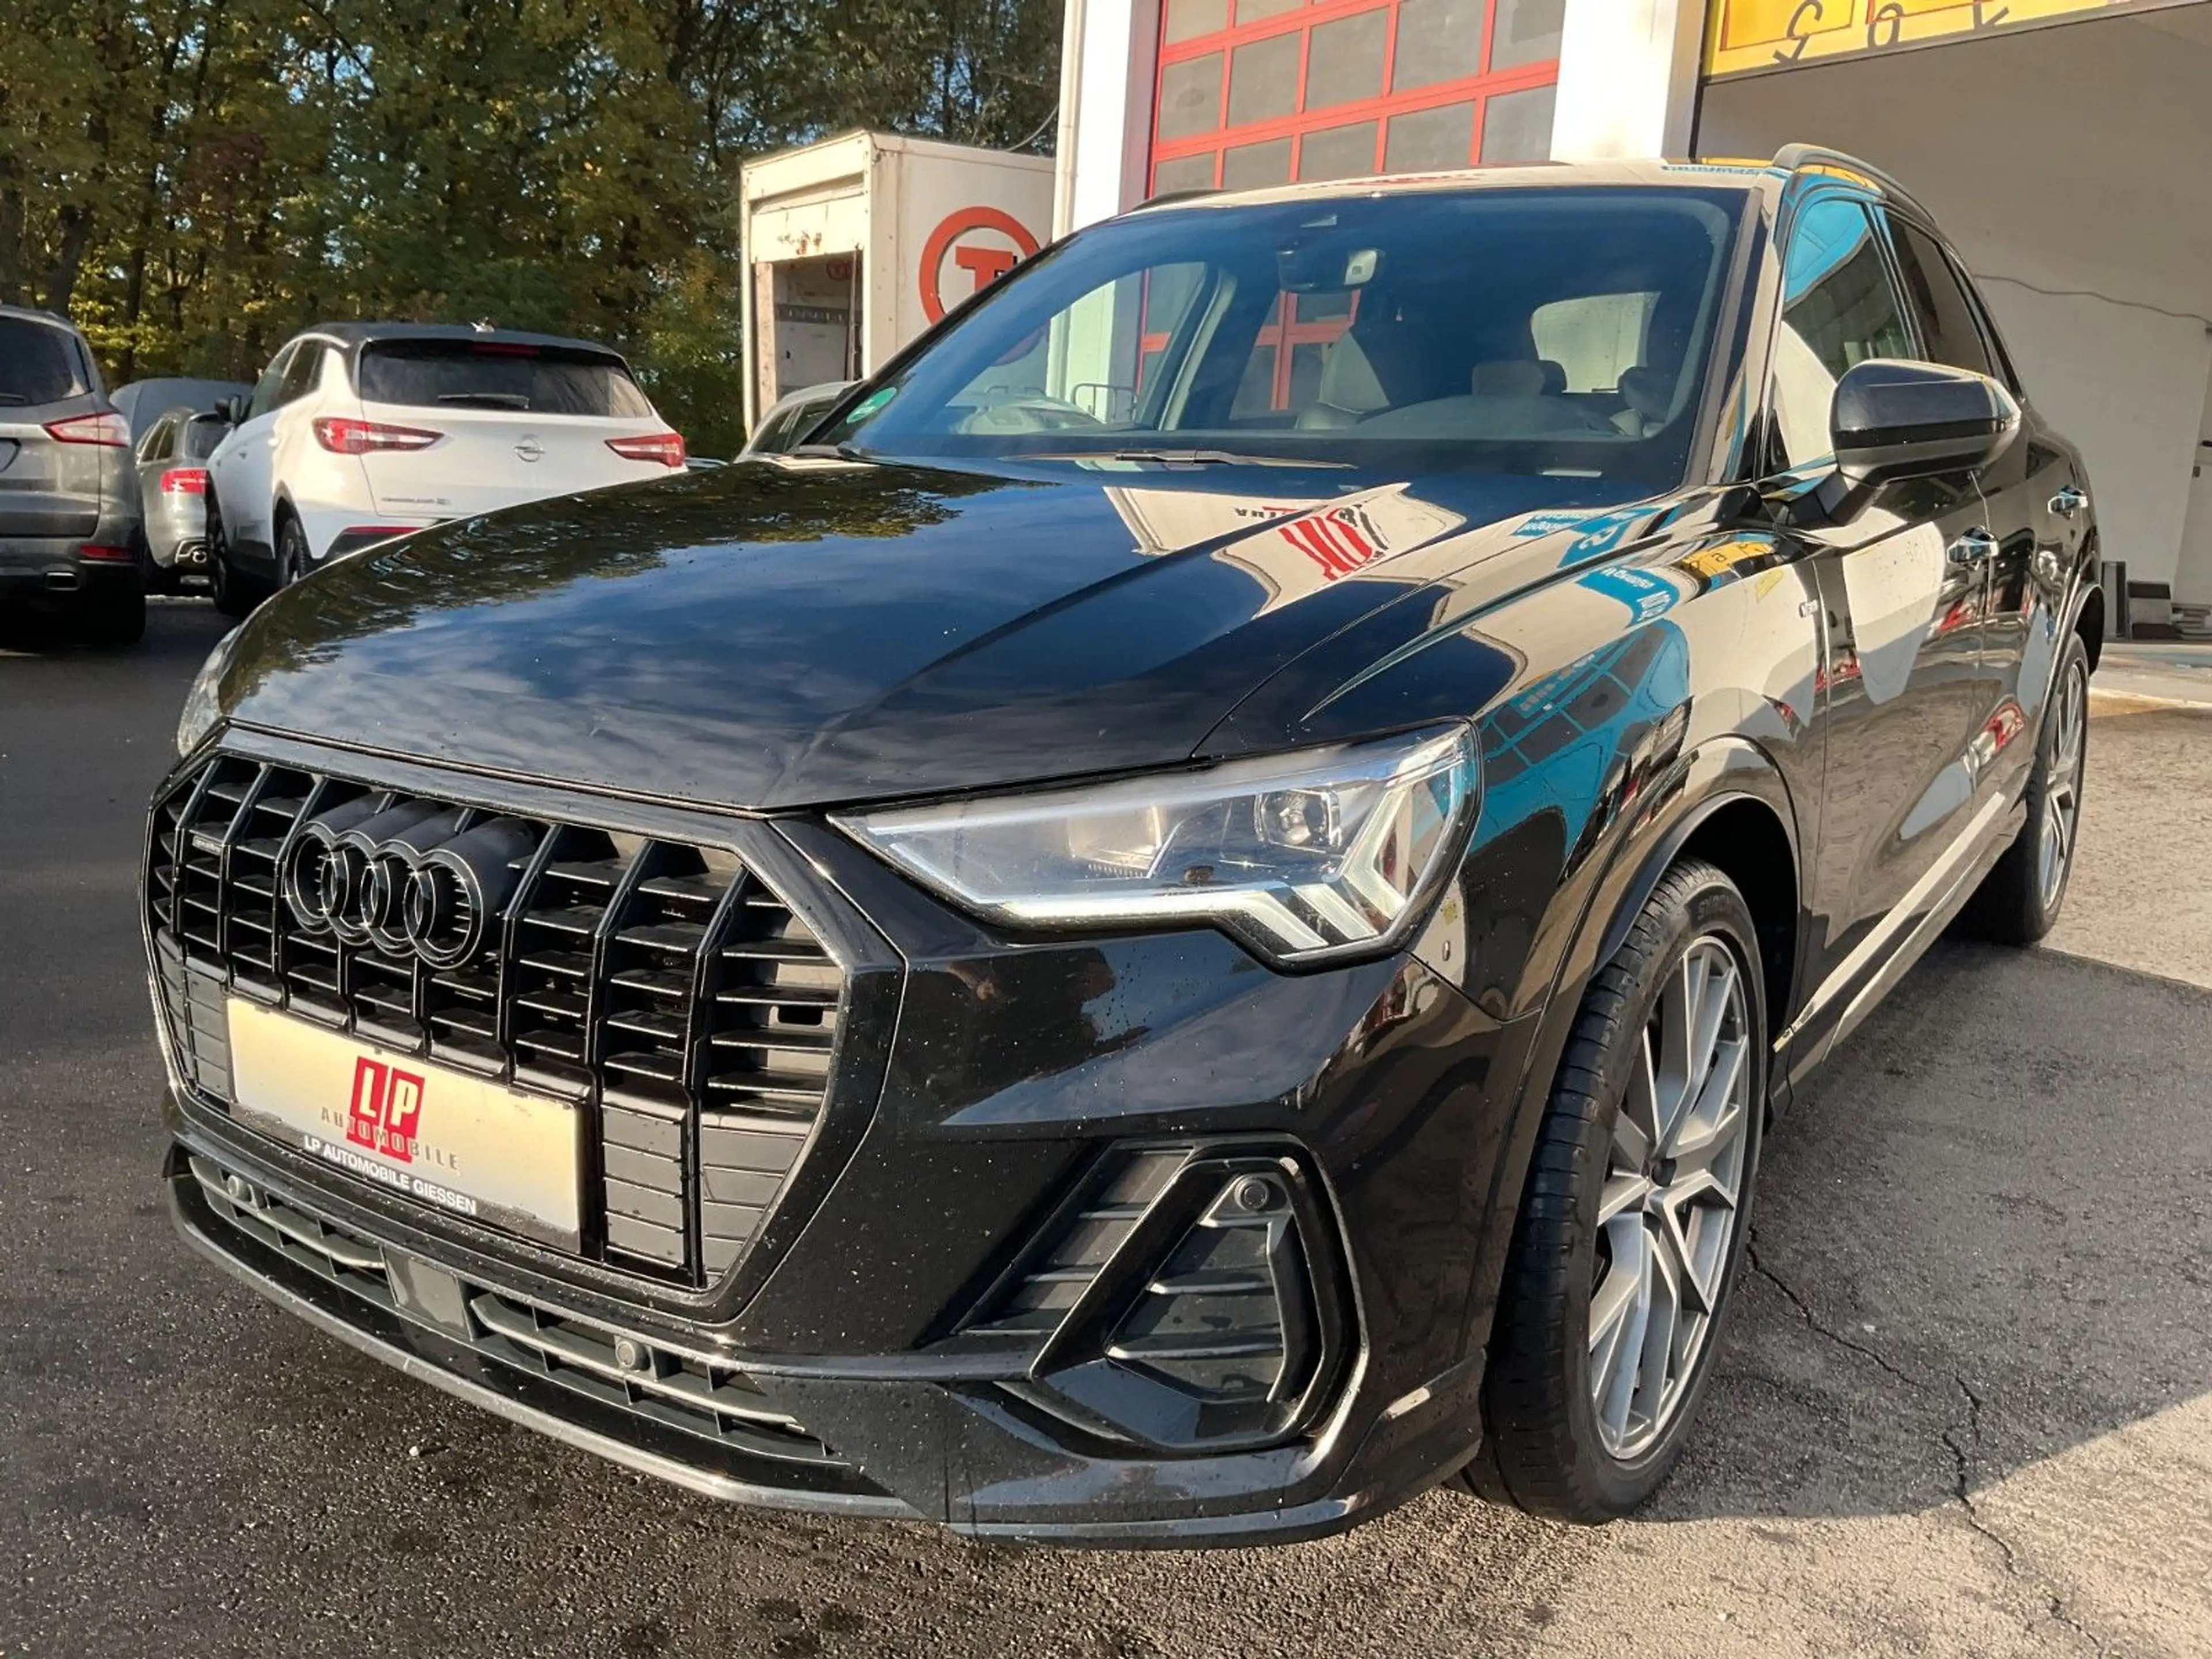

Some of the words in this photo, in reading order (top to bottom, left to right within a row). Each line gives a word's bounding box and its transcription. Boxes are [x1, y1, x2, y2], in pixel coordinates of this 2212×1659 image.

[359, 1066, 419, 1128] LP
[321, 1107, 460, 1171] AUTOMOBILE
[304, 1135, 320, 1150] LP
[323, 1143, 410, 1190] AUTOMOBILE
[413, 1179, 477, 1214] GIESSEN
